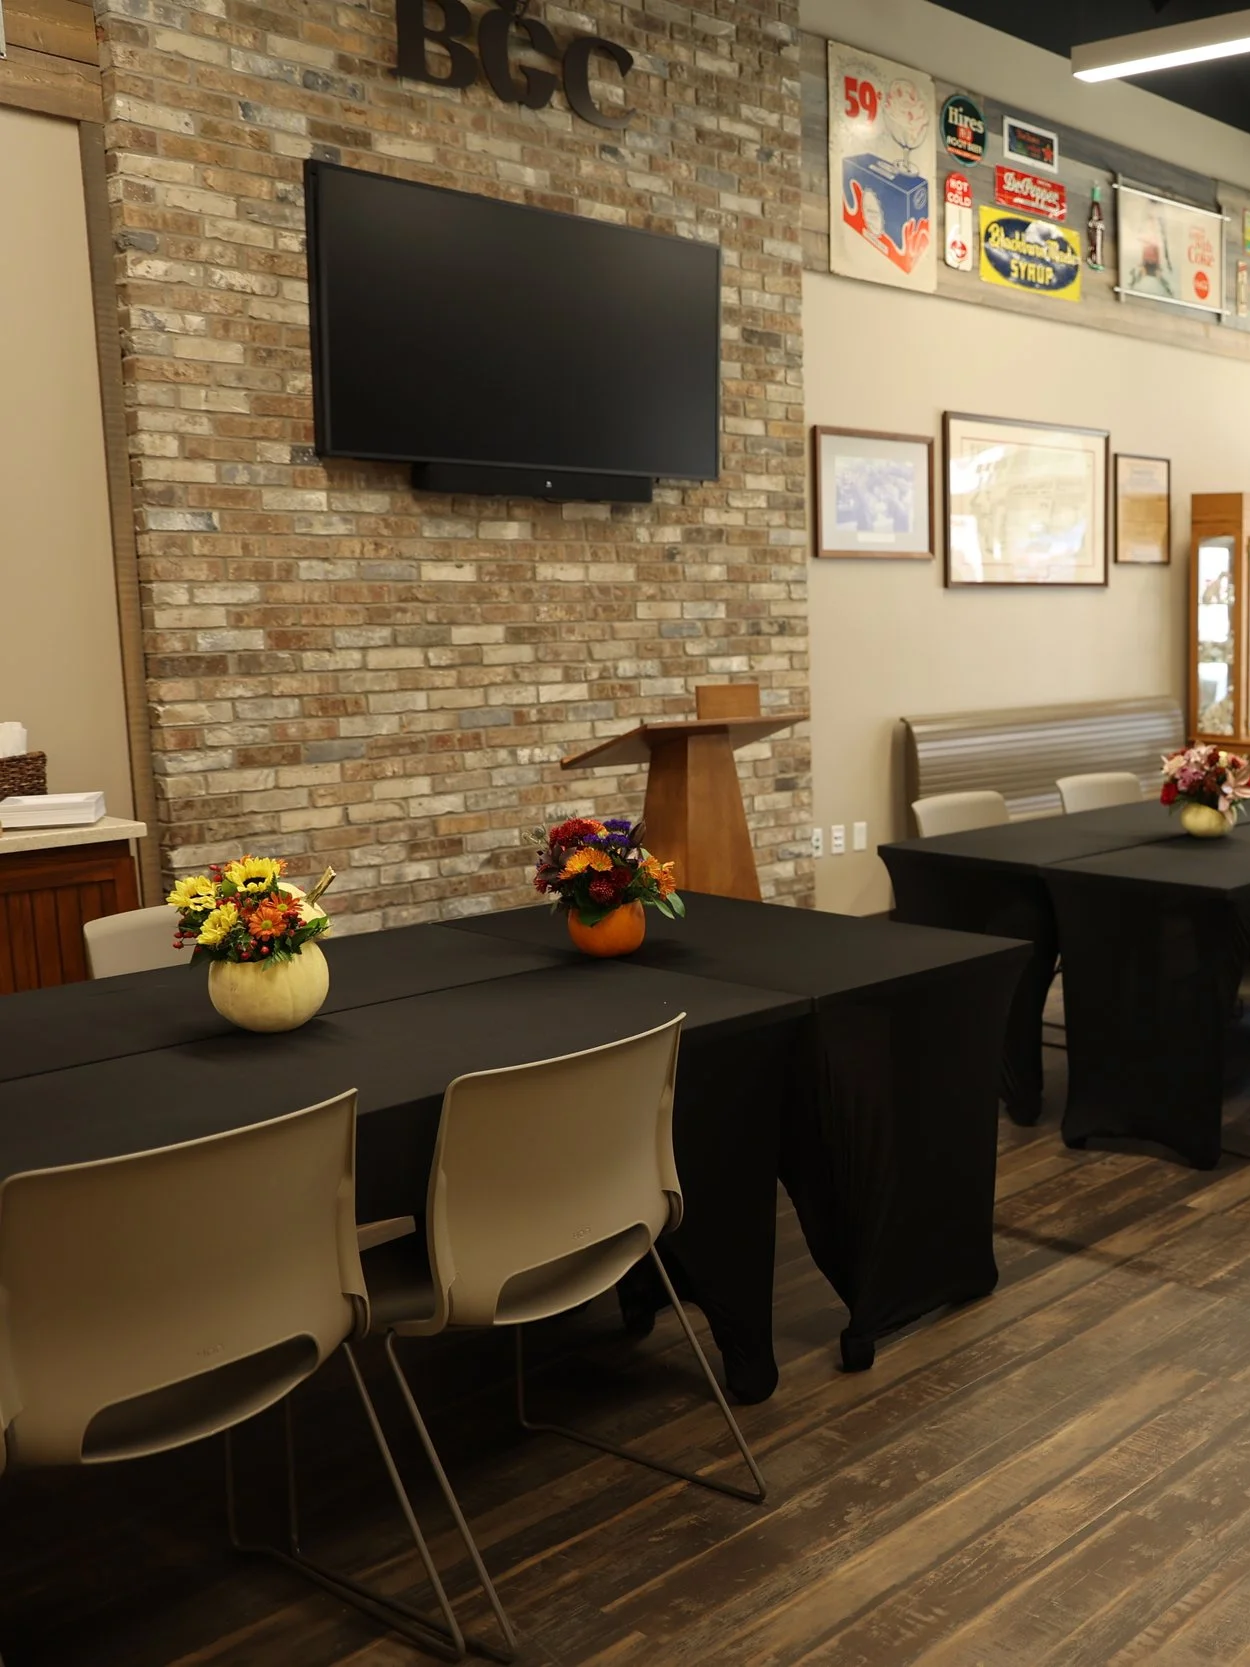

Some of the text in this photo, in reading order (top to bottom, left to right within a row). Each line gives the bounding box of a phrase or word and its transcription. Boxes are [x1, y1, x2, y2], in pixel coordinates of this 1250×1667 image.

[388, 0, 637, 130] BGC
[948, 106, 984, 134] Hires
[949, 178, 969, 192] HOT
[947, 192, 971, 207] COLD
[1010, 259, 1054, 285] SYRUP
